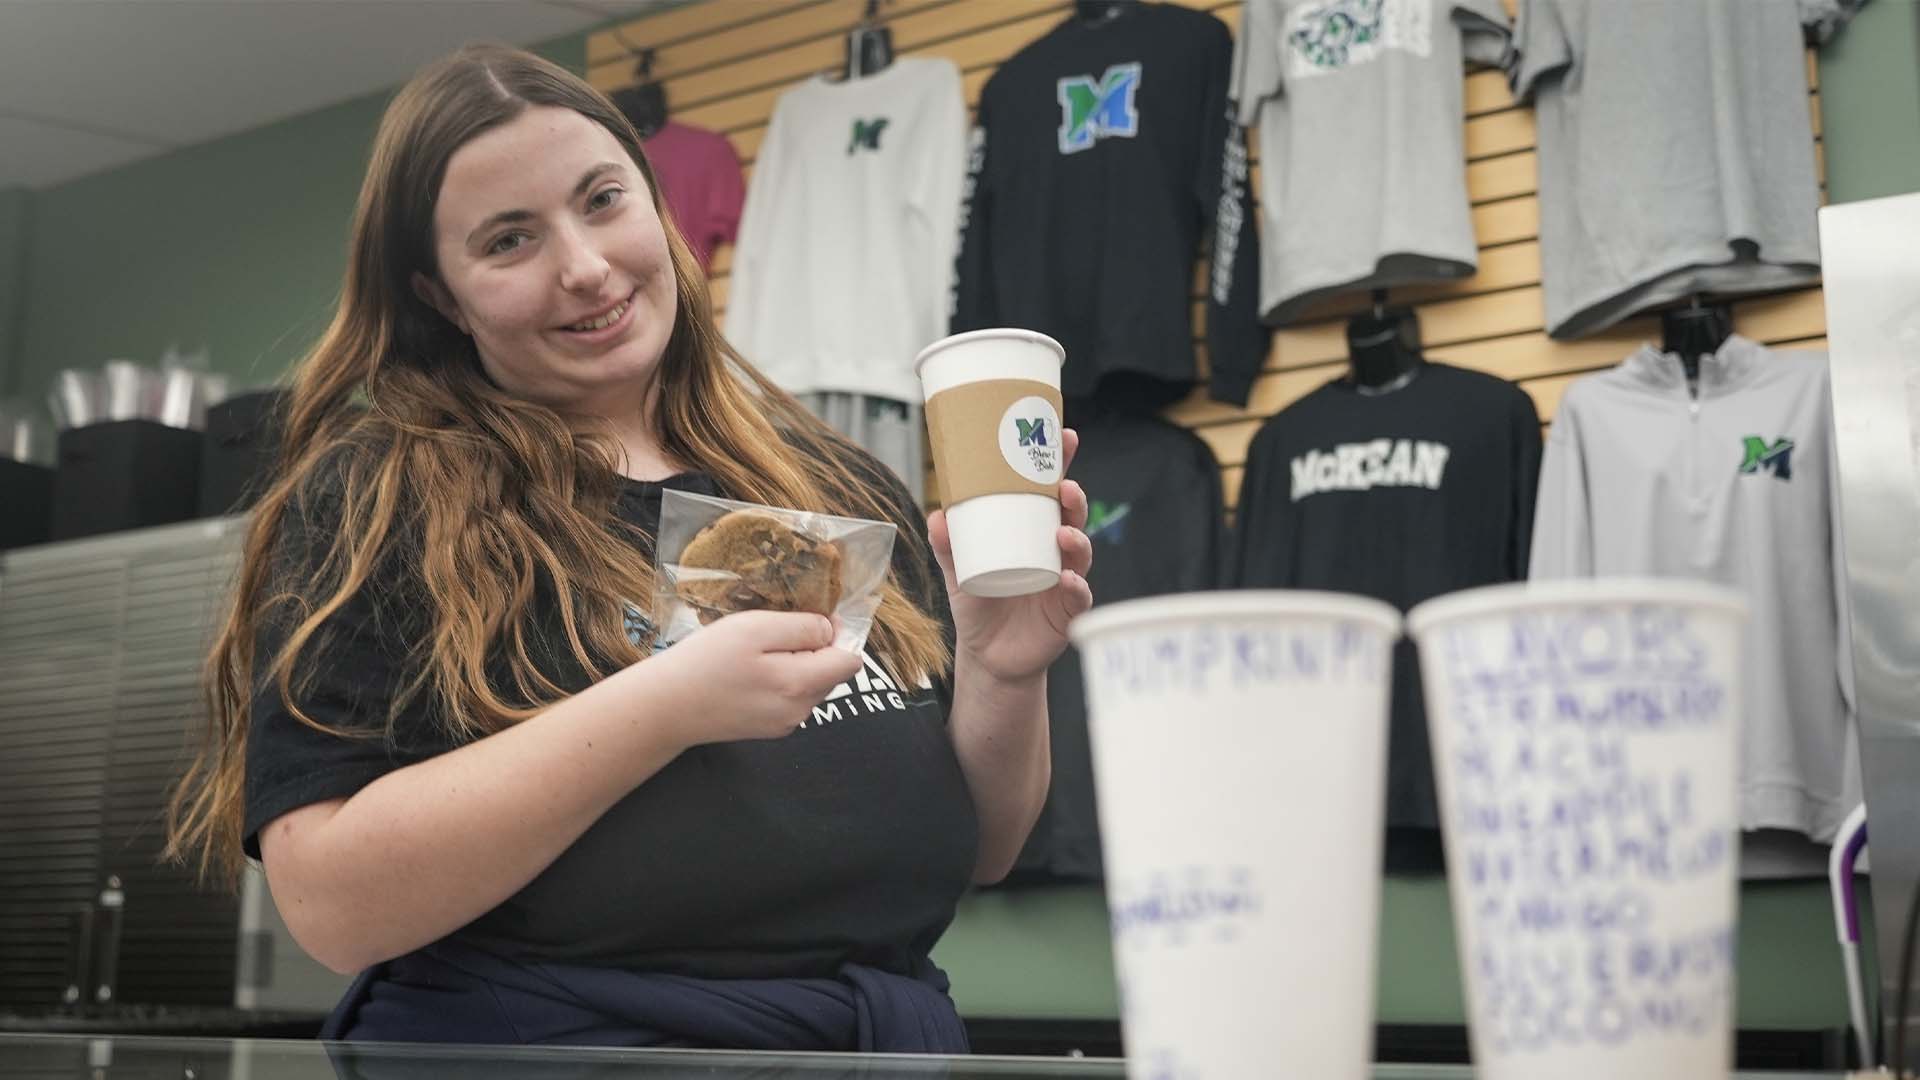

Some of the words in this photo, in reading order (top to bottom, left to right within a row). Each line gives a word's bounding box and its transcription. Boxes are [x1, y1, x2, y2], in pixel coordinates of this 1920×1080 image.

[1057, 62, 1142, 154] M
[1015, 417, 1048, 447] M
[1738, 435, 1794, 481] M
